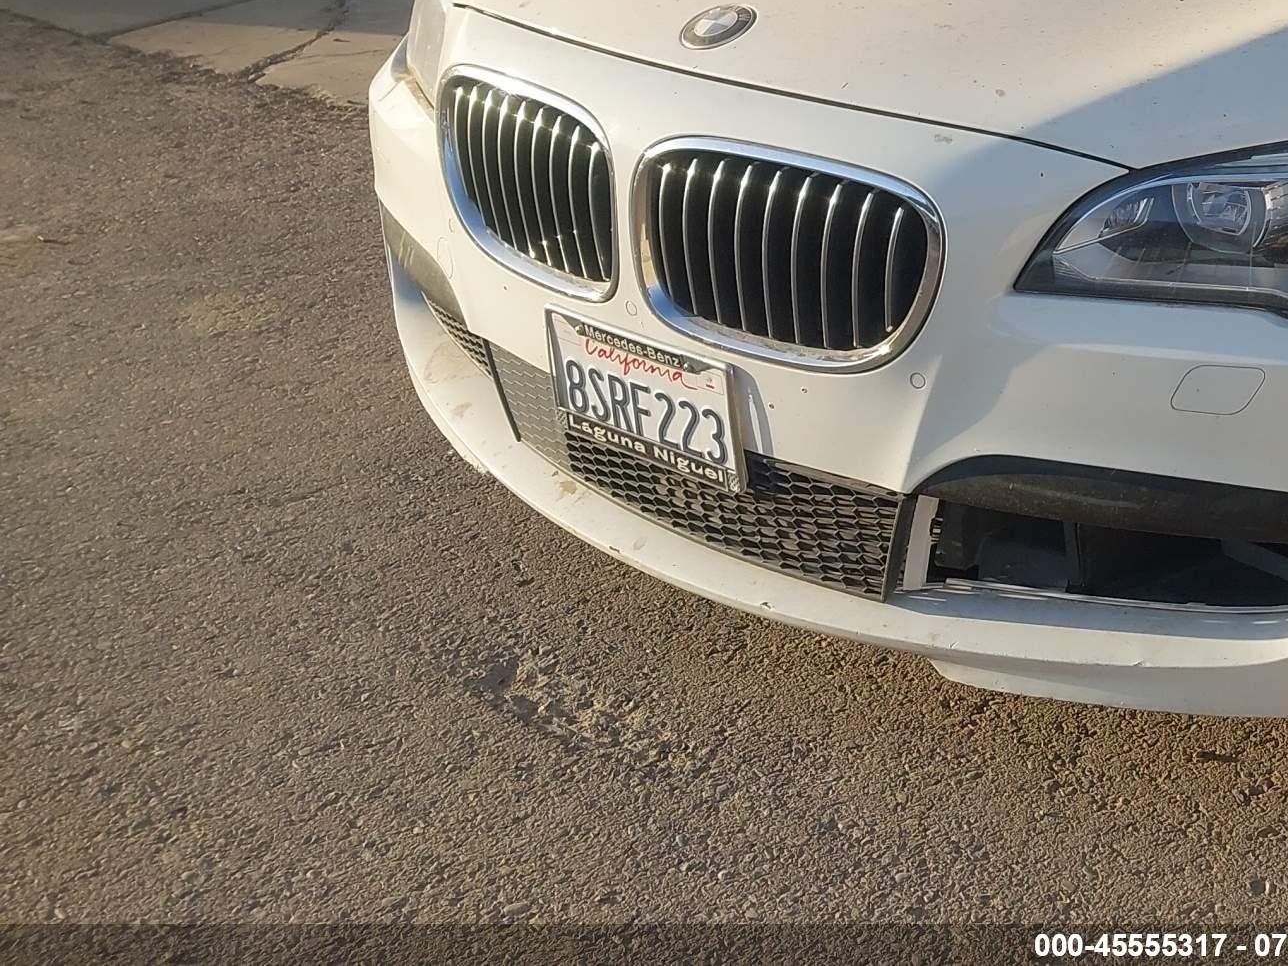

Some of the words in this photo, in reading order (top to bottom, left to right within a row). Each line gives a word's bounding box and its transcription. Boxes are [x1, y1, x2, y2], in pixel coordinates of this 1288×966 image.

[583, 324, 682, 368] Mercedes-Benz
[584, 338, 698, 391] California
[565, 359, 728, 466] 8SRF223
[569, 414, 647, 454] Laguna
[653, 445, 725, 484] Niguel
